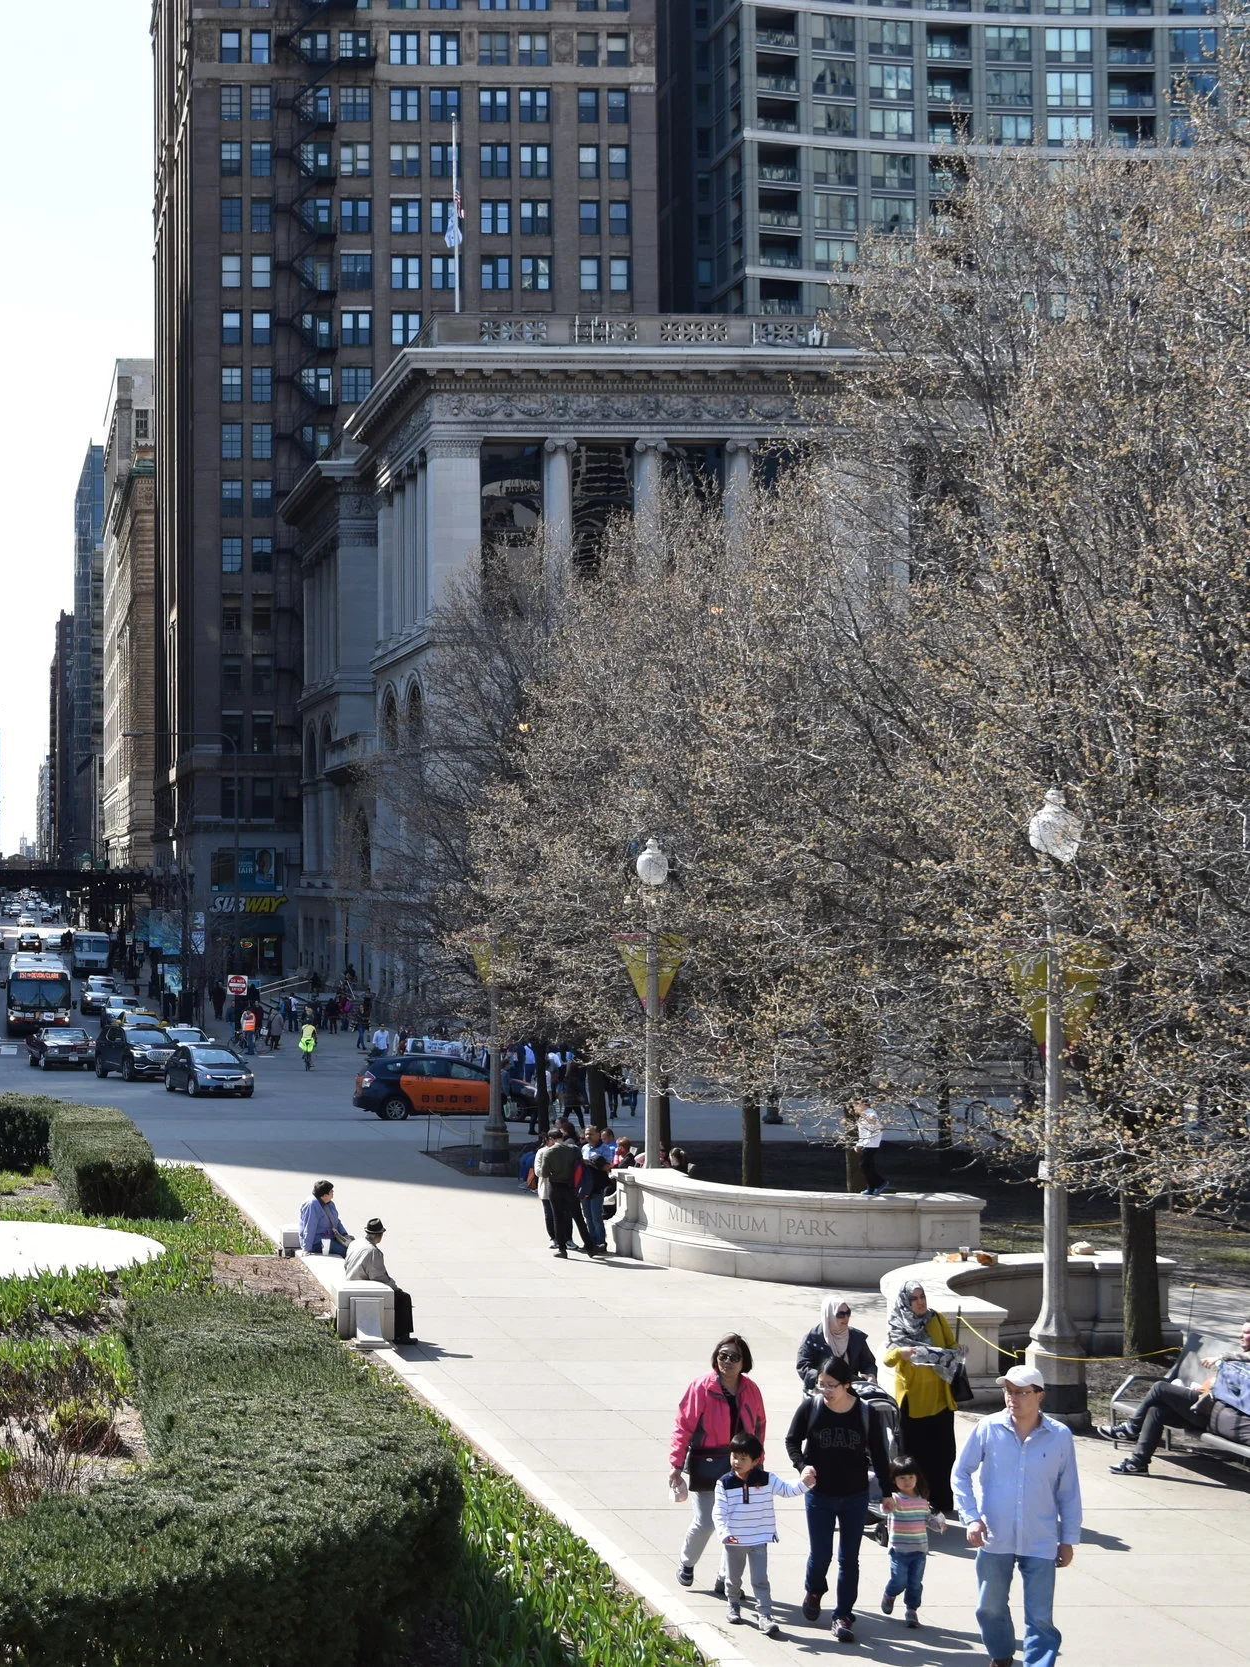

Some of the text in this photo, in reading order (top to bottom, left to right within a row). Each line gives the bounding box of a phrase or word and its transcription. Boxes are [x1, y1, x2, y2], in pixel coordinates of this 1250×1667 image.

[209, 896, 287, 913] SUBWAY
[668, 1206, 838, 1237] MILLENNIUM PARK
[819, 1427, 862, 1450] GAP
